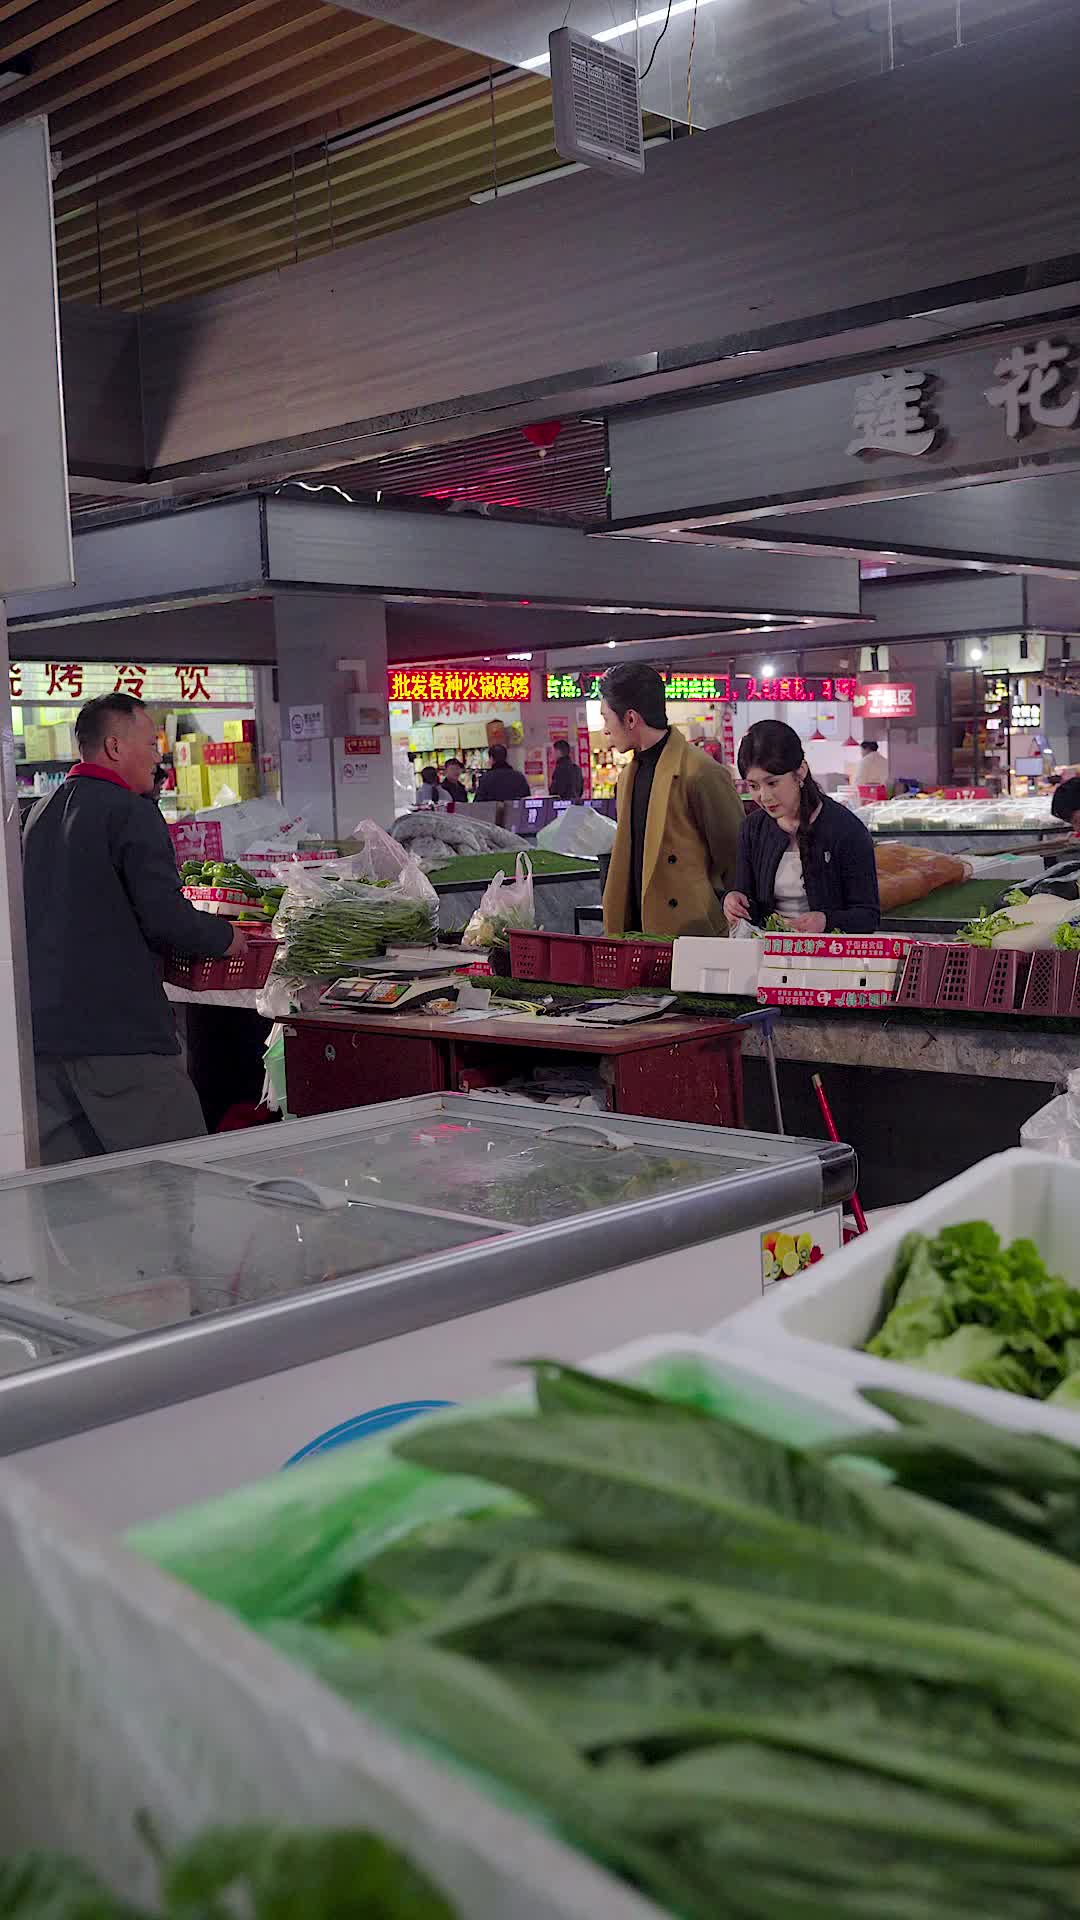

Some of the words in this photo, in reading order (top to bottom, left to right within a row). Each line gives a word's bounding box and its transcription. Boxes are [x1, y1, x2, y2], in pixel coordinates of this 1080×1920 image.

[391, 673, 529, 699] 批发各种火锅烧烤
